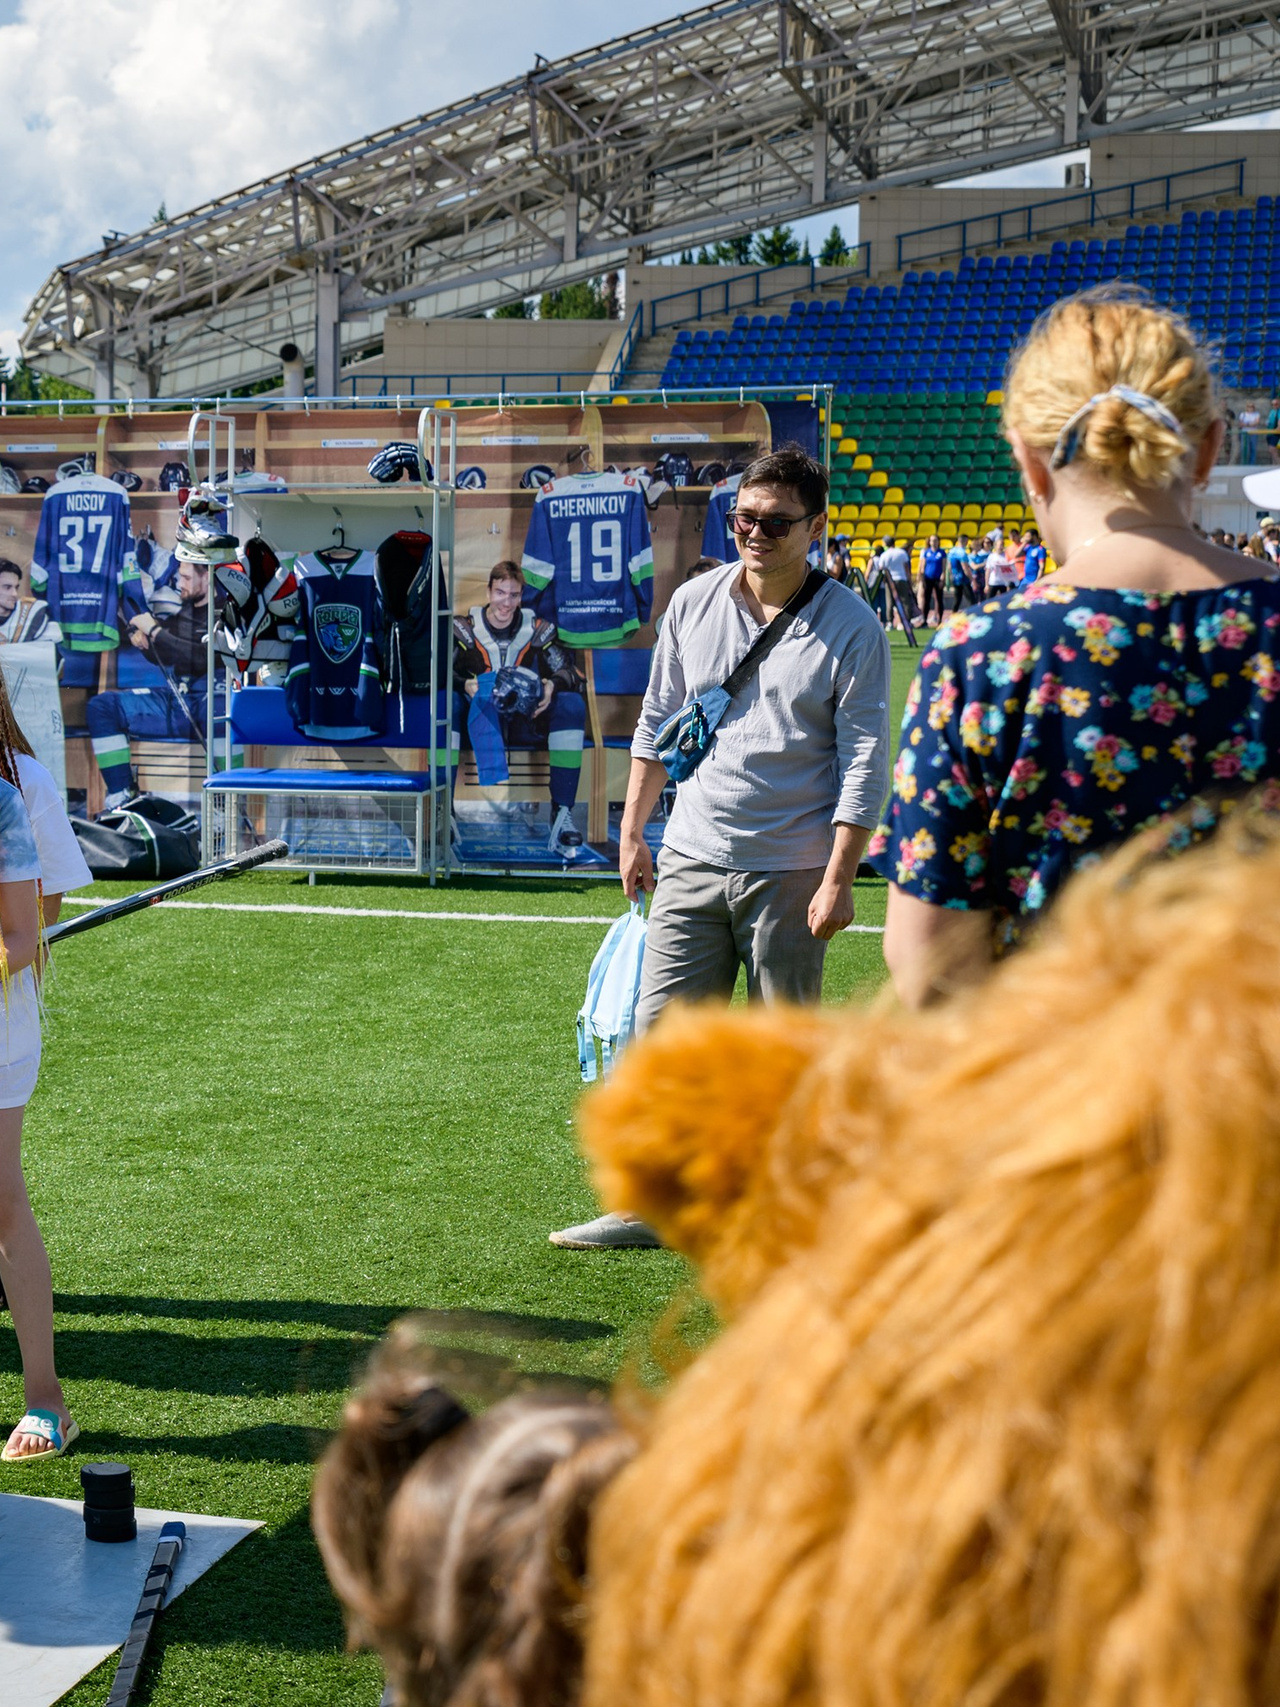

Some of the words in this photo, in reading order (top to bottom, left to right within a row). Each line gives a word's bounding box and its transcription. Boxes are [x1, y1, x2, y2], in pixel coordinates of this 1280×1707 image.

[66, 494, 106, 511] NOSOV
[549, 495, 627, 518] CHERNIKOV
[58, 515, 113, 573] 37
[567, 520, 622, 582] 19
